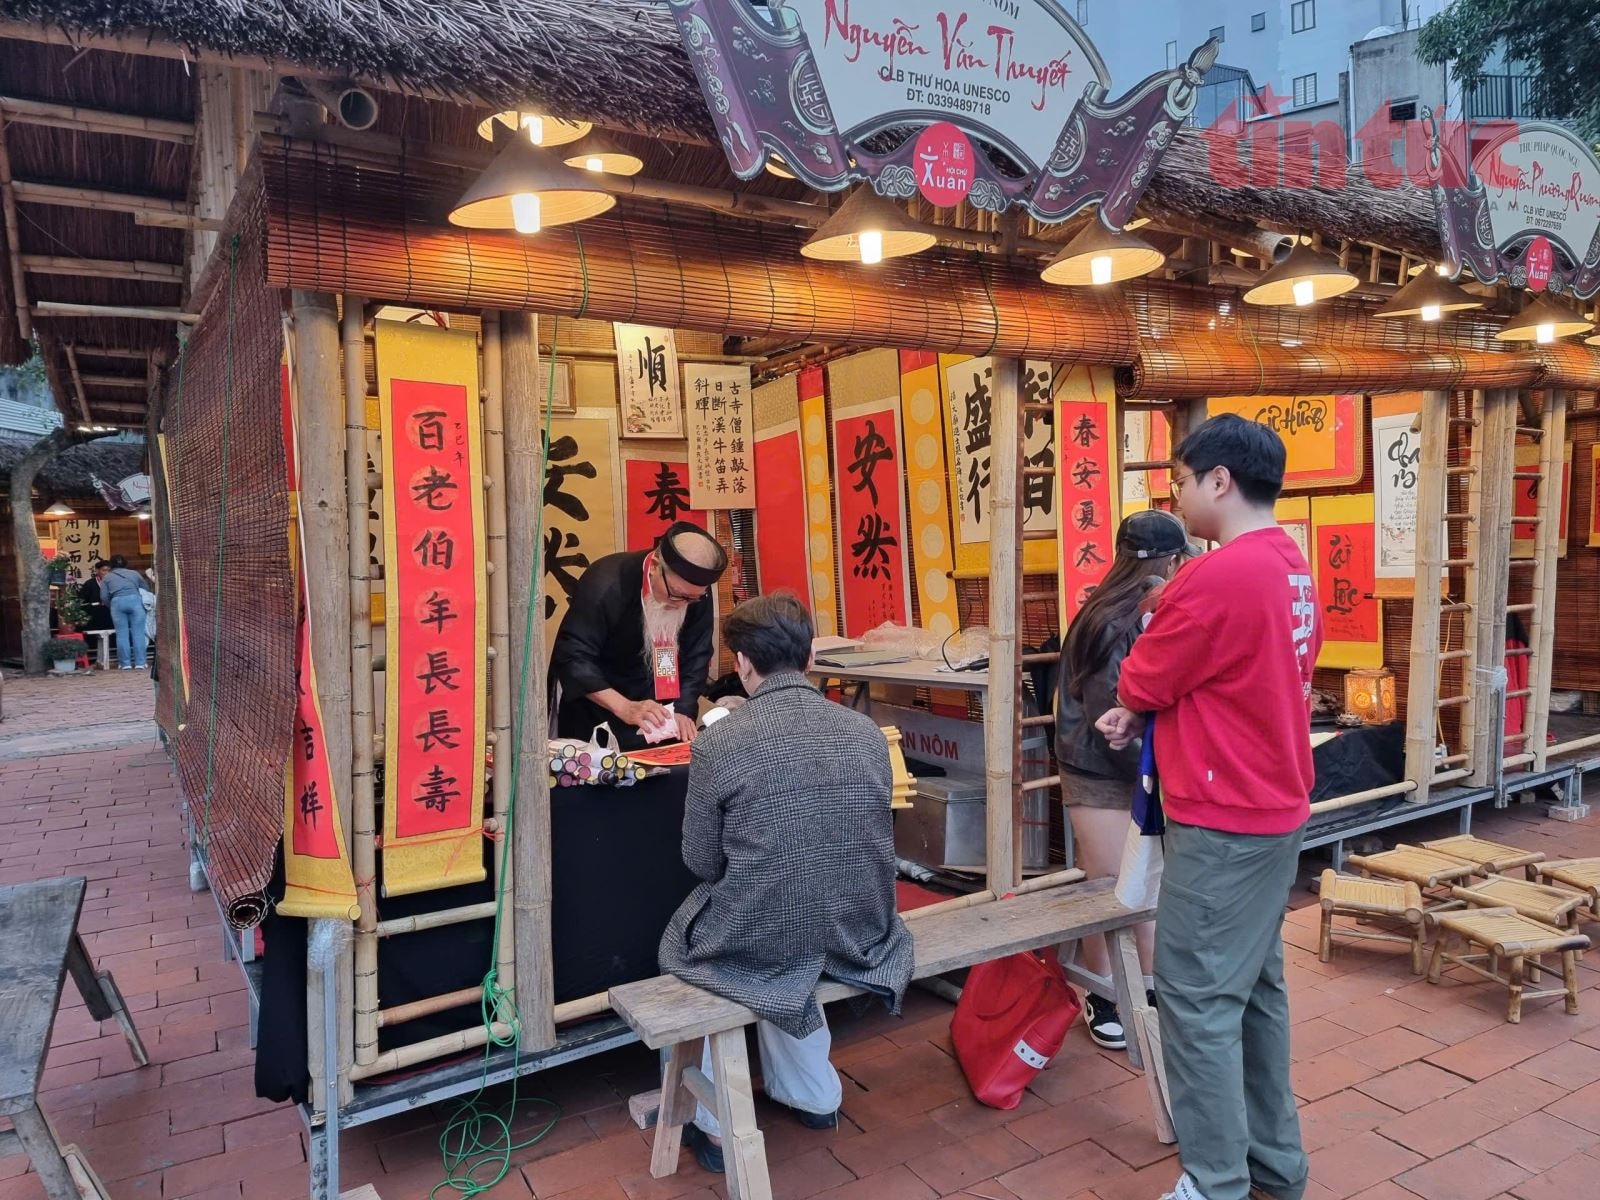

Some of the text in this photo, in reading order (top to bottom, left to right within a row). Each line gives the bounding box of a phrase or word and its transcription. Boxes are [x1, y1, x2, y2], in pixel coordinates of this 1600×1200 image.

[824, 0, 1073, 111] Nguyễn Văn Thuyết
[880, 66, 905, 82] CLB
[908, 71, 934, 88] THƯ
[963, 82, 1011, 103] UNESCO
[906, 88, 991, 115] ĐT: 0339489718
[1546, 210, 1567, 221] UNESCO
[637, 336, 667, 397] 順
[643, 462, 690, 521] 春
[847, 419, 898, 581] 安然
[411, 410, 462, 814] 百老伯年長長壽
[920, 733, 959, 760] NÔM
